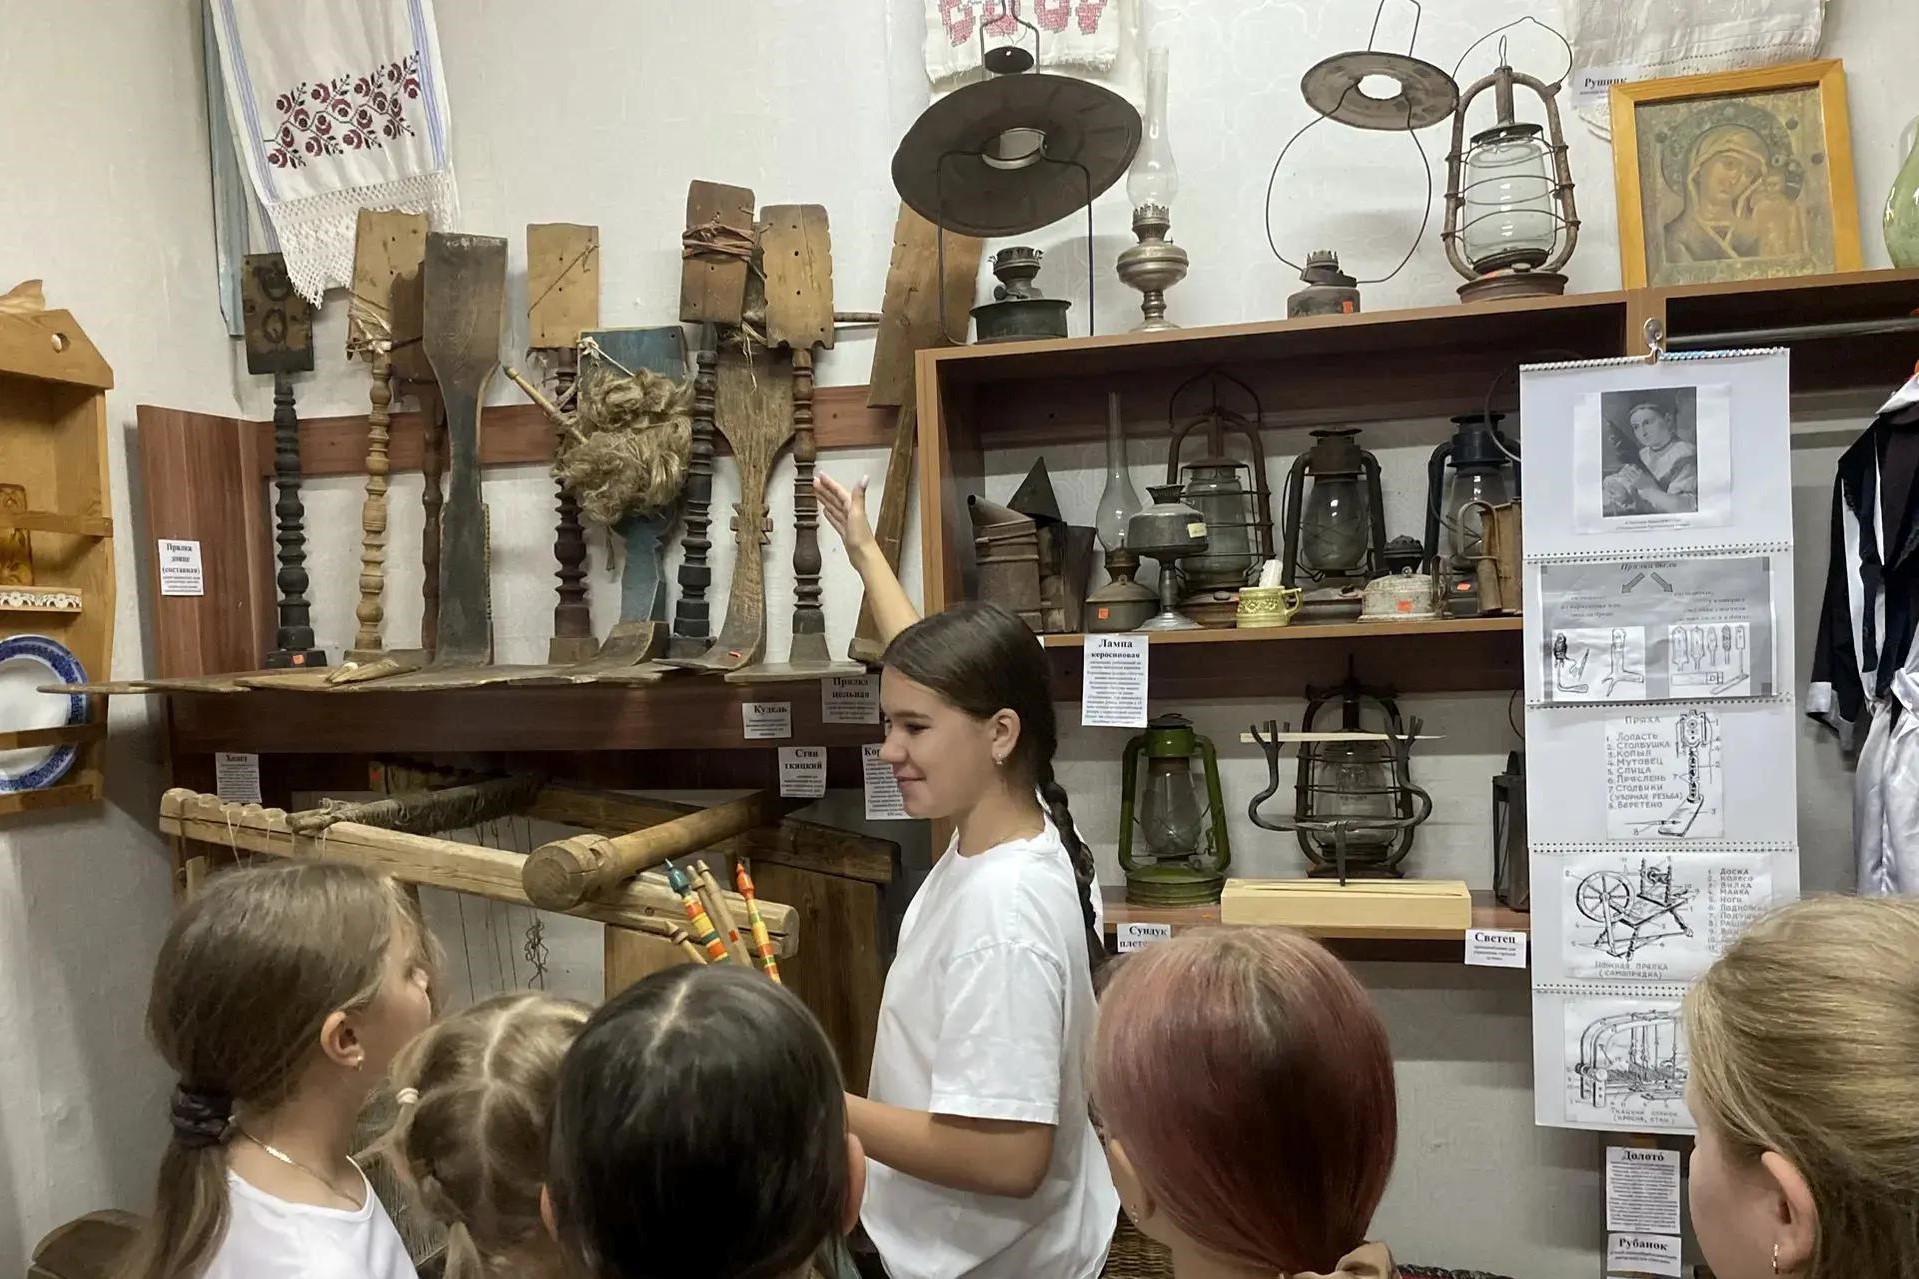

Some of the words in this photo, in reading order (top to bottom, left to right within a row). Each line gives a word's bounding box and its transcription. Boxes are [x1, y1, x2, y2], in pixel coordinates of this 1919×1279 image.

[1099, 639, 1133, 648] Лампа
[833, 677, 869, 688] Прялка
[832, 690, 870, 699] цельная
[754, 705, 788, 715] Кудель
[795, 749, 819, 758] Стан
[784, 762, 822, 770] ткацкий
[1129, 926, 1168, 936] Сундук
[1475, 932, 1516, 943] Светец
[1619, 1238, 1669, 1251] Рубанок
